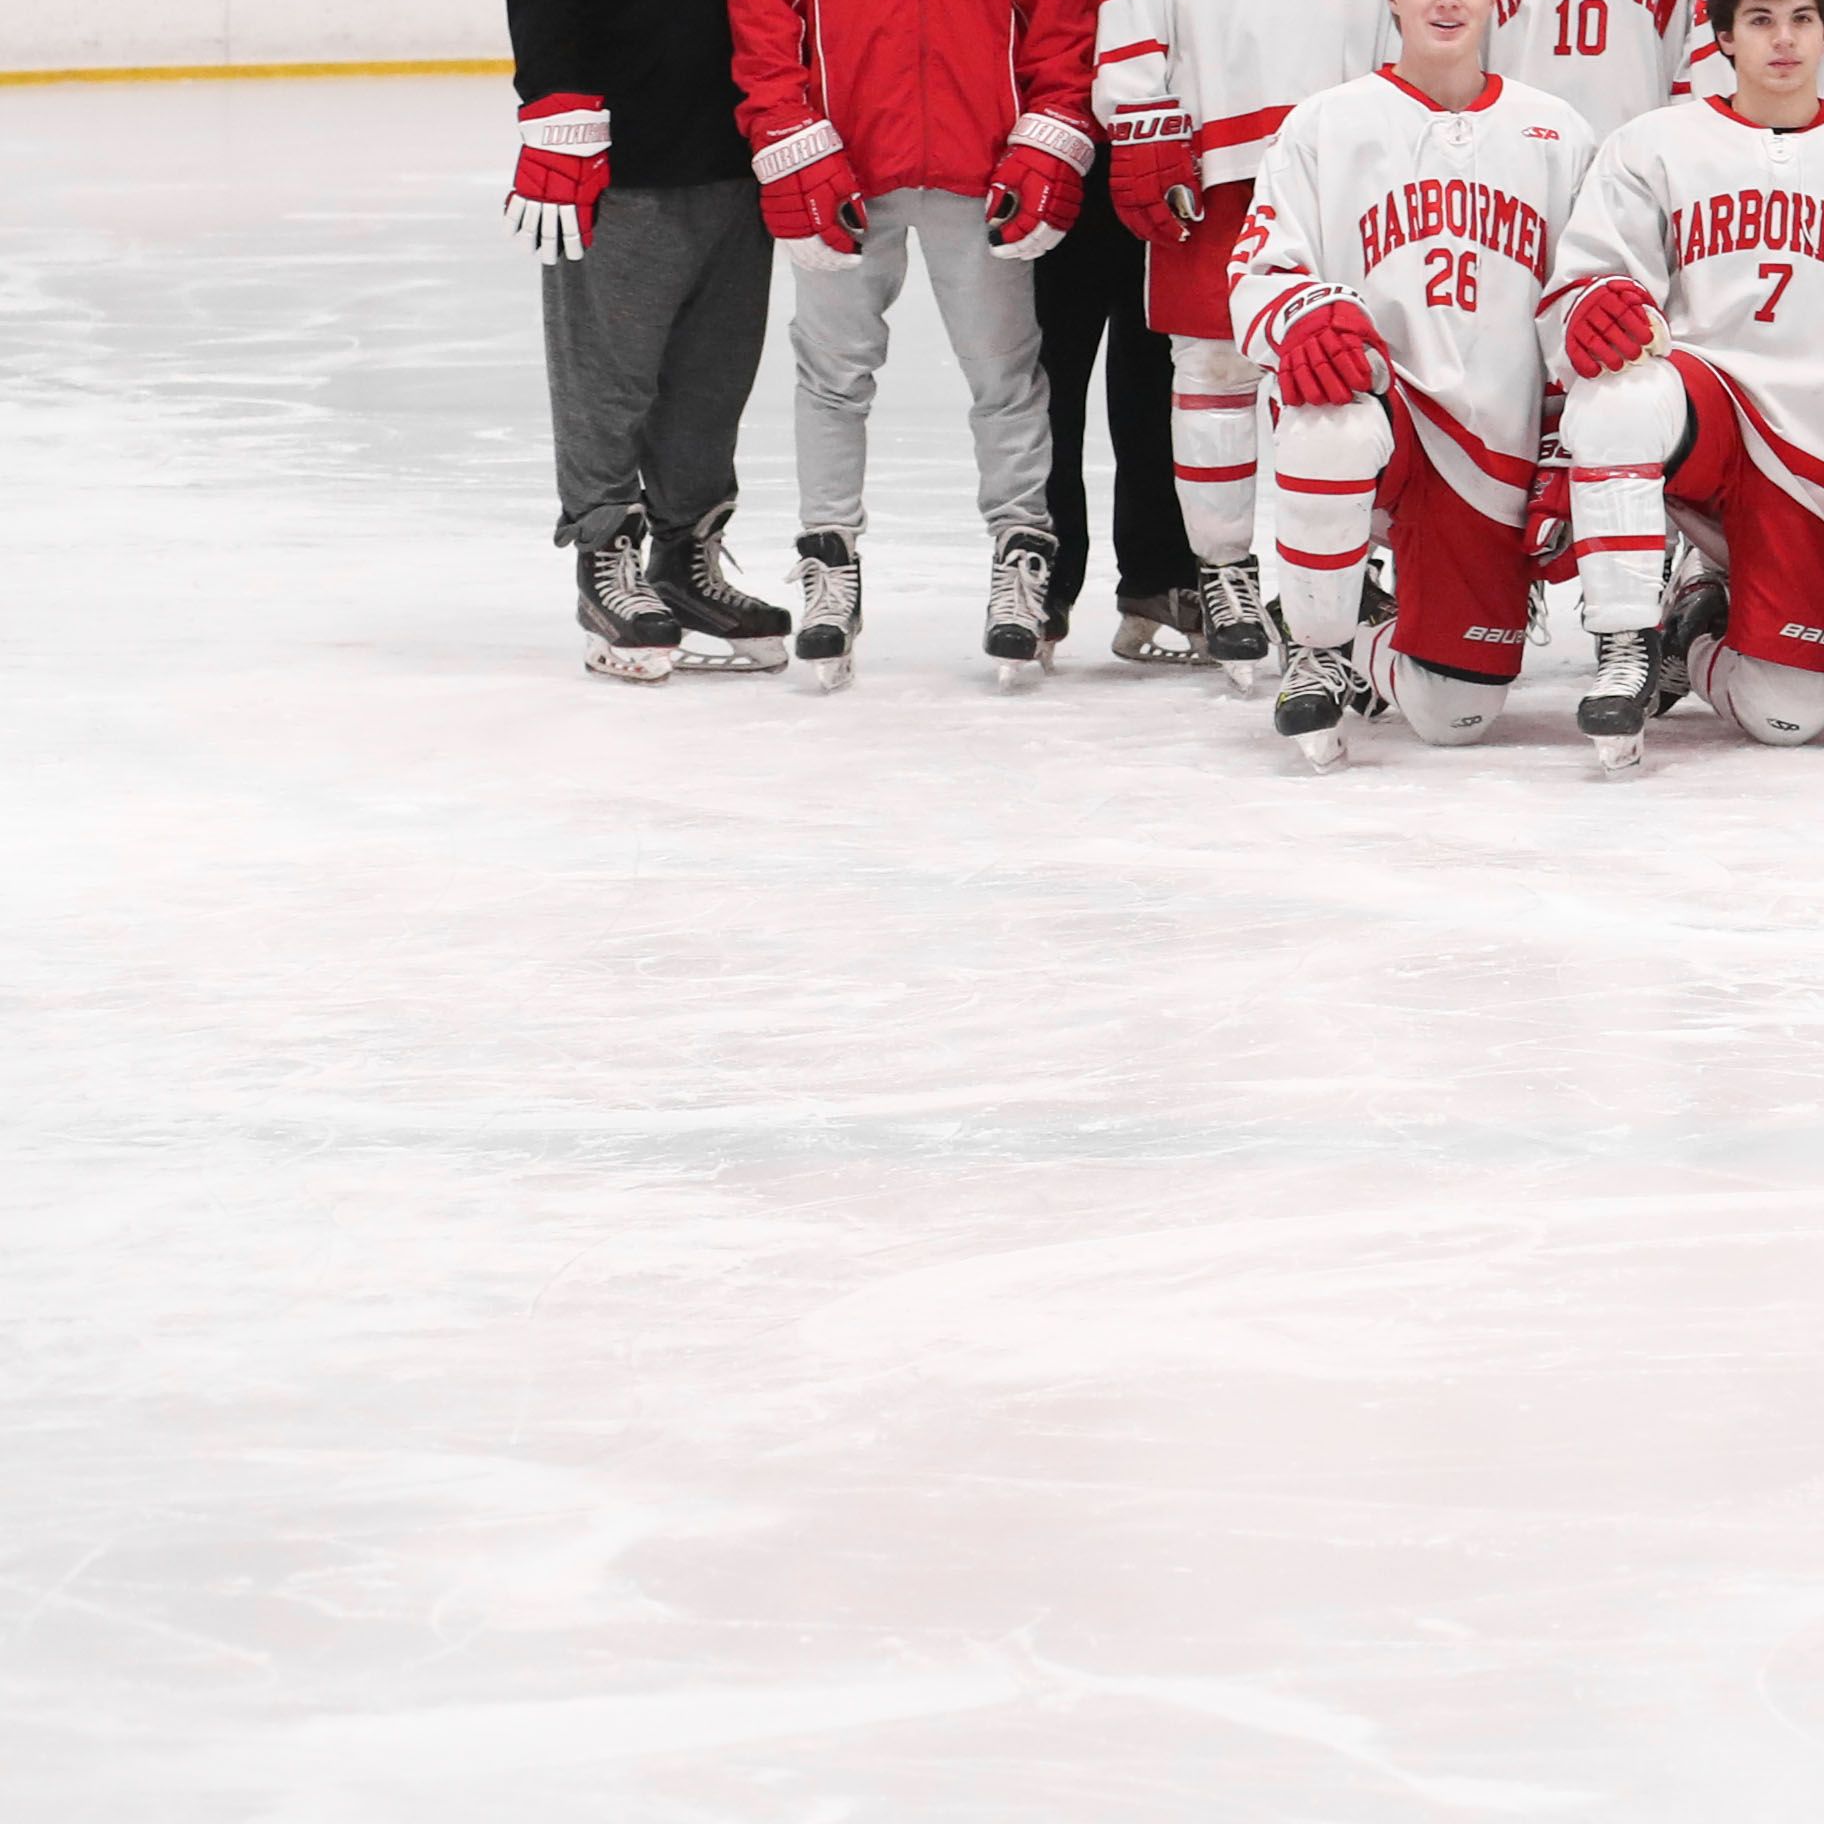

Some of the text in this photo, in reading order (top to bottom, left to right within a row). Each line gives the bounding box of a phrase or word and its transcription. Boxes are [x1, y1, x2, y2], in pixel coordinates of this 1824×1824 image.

[1555, 0, 1608, 55] 10
[1425, 249, 1477, 311] 26
[1756, 263, 1792, 322] 7
